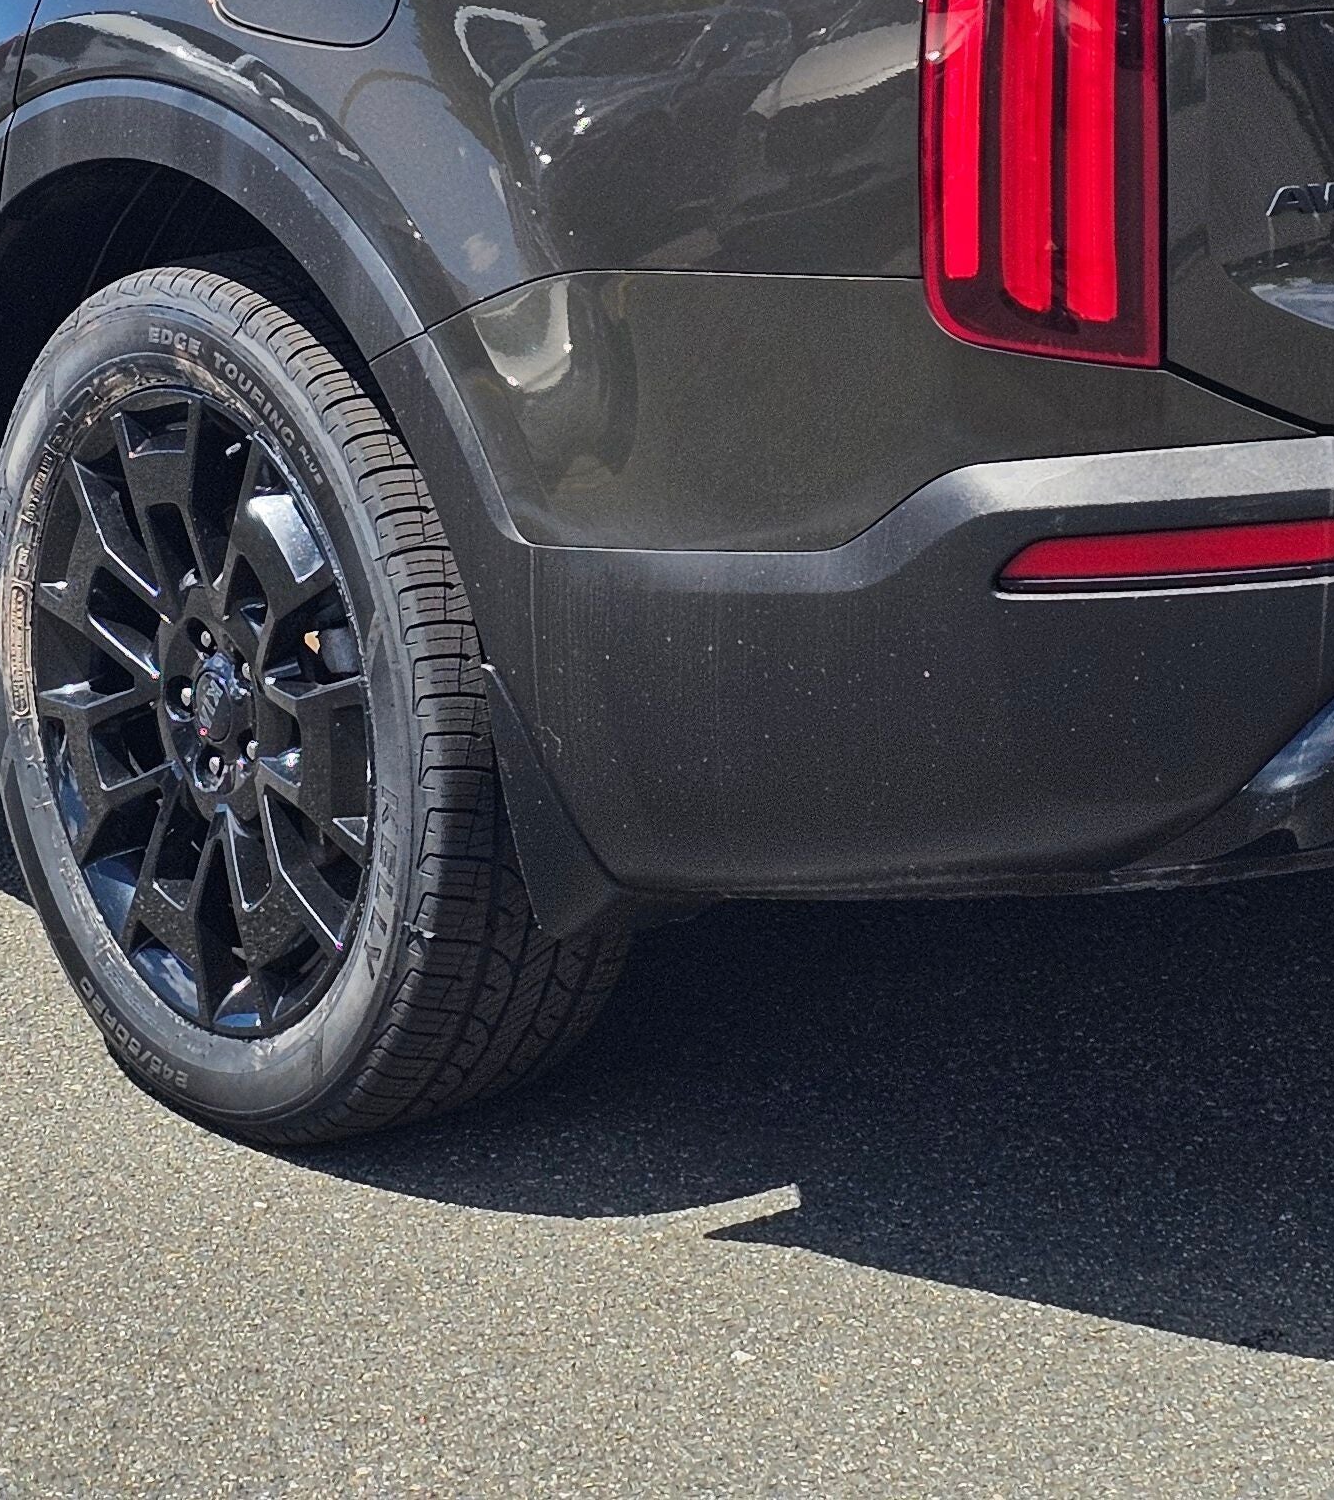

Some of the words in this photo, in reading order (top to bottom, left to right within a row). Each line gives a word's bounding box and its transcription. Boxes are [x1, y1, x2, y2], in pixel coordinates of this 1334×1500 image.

[148, 326, 202, 357] EDGE
[212, 351, 295, 448] TOURING
[364, 785, 399, 981] KELLY
